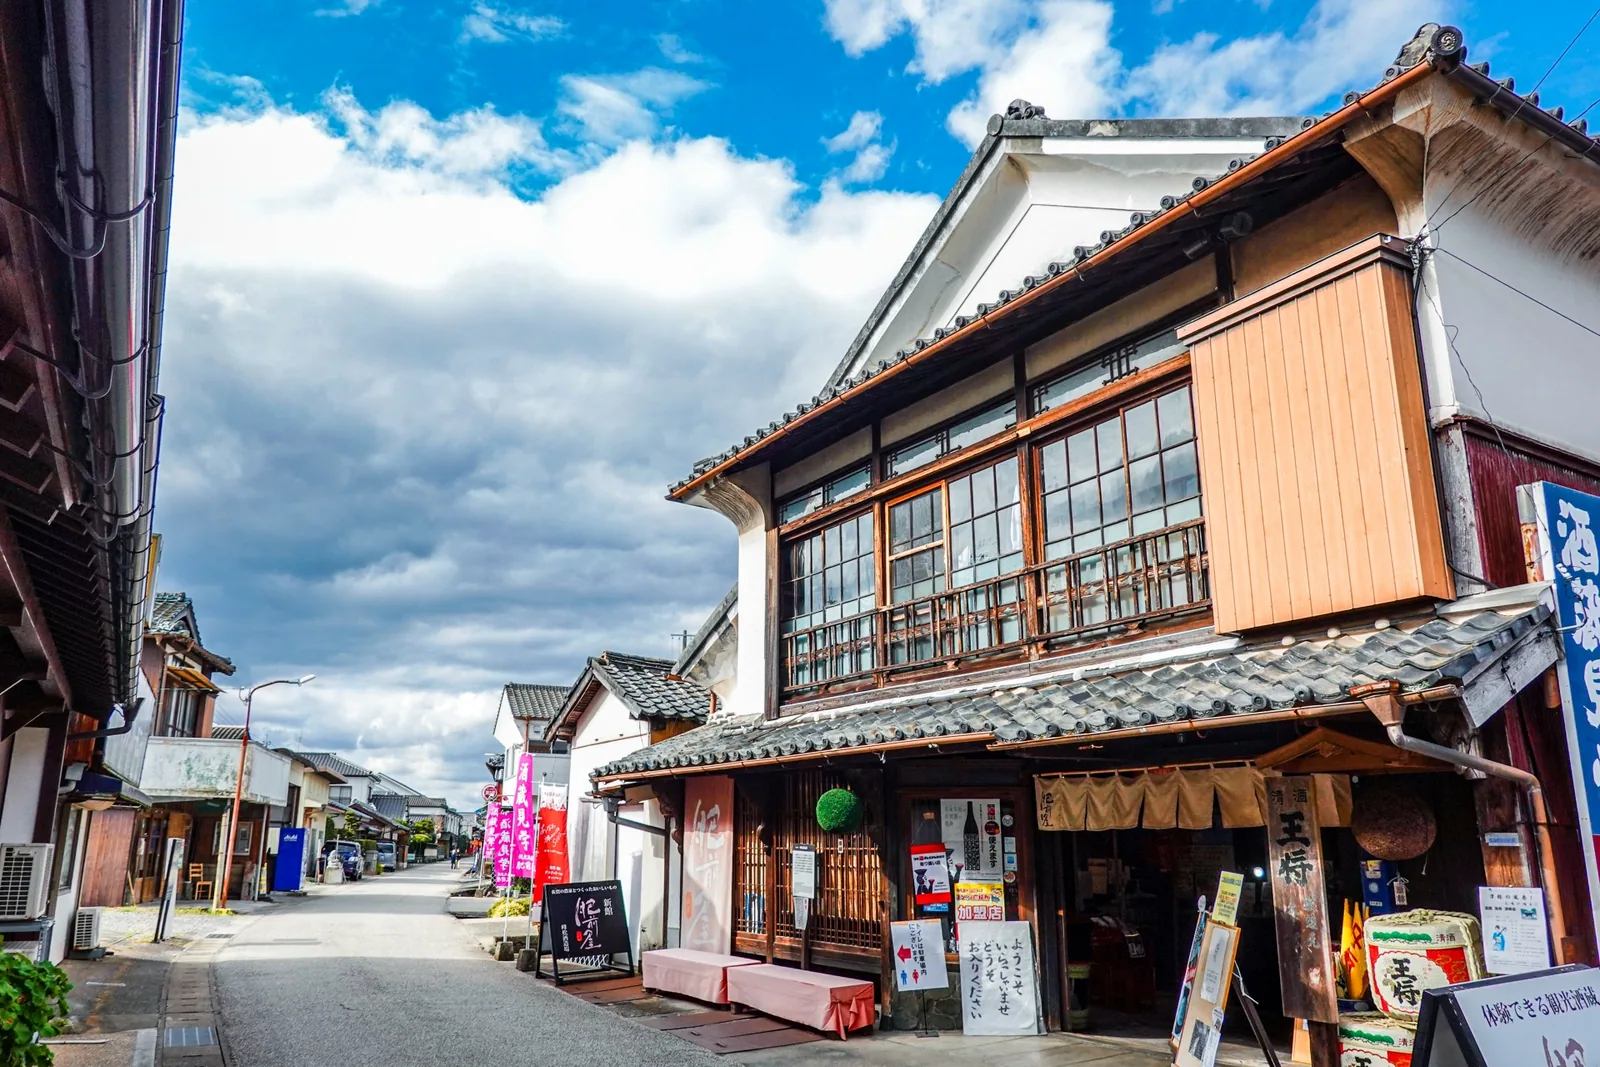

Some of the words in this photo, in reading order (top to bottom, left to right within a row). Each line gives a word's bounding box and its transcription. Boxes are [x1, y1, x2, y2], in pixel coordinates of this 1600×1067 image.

[516, 762, 531, 852] 酒蔵見学
[1271, 788, 1307, 806] 清酒
[687, 799, 726, 945] 肥前屋
[988, 836, 998, 868] 使えます
[1276, 811, 1314, 886] 王将
[574, 897, 602, 950] 肥前屋
[603, 898, 614, 916] 新館
[957, 904, 1003, 920] 加盟店
[916, 923, 927, 976] トイレは駐車場内
[983, 940, 995, 983] どうぞ
[1435, 932, 1456, 942] 清酒
[968, 941, 982, 1019] お入りください
[996, 942, 1010, 1016] いらっしゃいませ
[1011, 938, 1024, 996] ようこそ
[1391, 957, 1421, 1006] 王将
[1481, 985, 1600, 1028] 体験できる観光酒蔵
